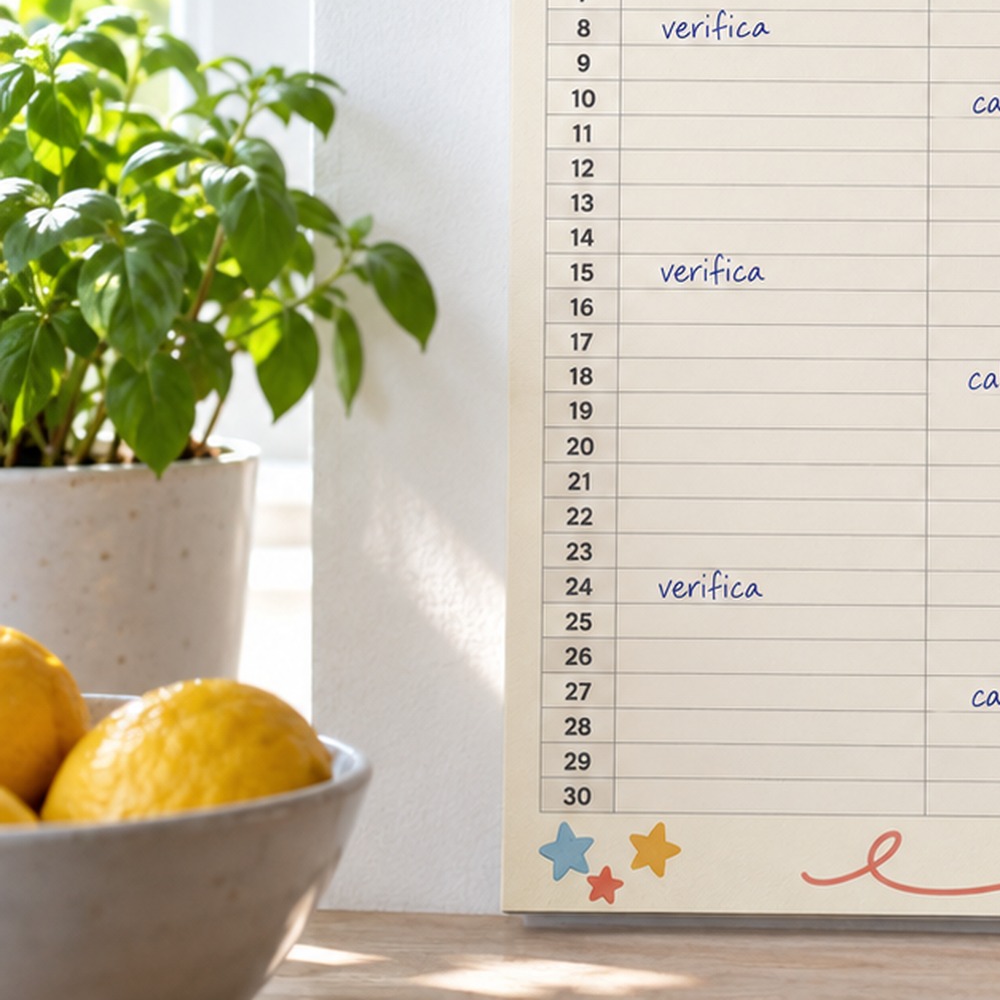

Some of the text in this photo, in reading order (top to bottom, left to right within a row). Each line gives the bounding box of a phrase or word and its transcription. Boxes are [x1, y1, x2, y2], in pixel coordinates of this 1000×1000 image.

[576, 17, 592, 39] 8
[662, 9, 769, 40] verifica
[576, 52, 591, 74] 9
[571, 88, 597, 109] 10
[572, 123, 592, 144] 11
[570, 157, 595, 179] 12
[570, 192, 595, 213] 13
[569, 227, 595, 248] 14
[569, 262, 595, 283] 15
[660, 253, 765, 285] verifica
[569, 296, 595, 318] 16
[569, 331, 594, 352] 17
[568, 366, 594, 387] 18
[568, 400, 594, 421] 19
[565, 435, 595, 457] 20
[567, 470, 591, 492] 21
[565, 505, 594, 527] 22
[565, 541, 594, 562] 23
[564, 576, 594, 597] 24
[658, 569, 762, 599] verifica
[564, 611, 593, 632] 25
[564, 645, 593, 667] 26
[564, 681, 593, 702] 27
[563, 715, 592, 737] 28
[563, 750, 592, 772] 29
[562, 785, 593, 807] 30
